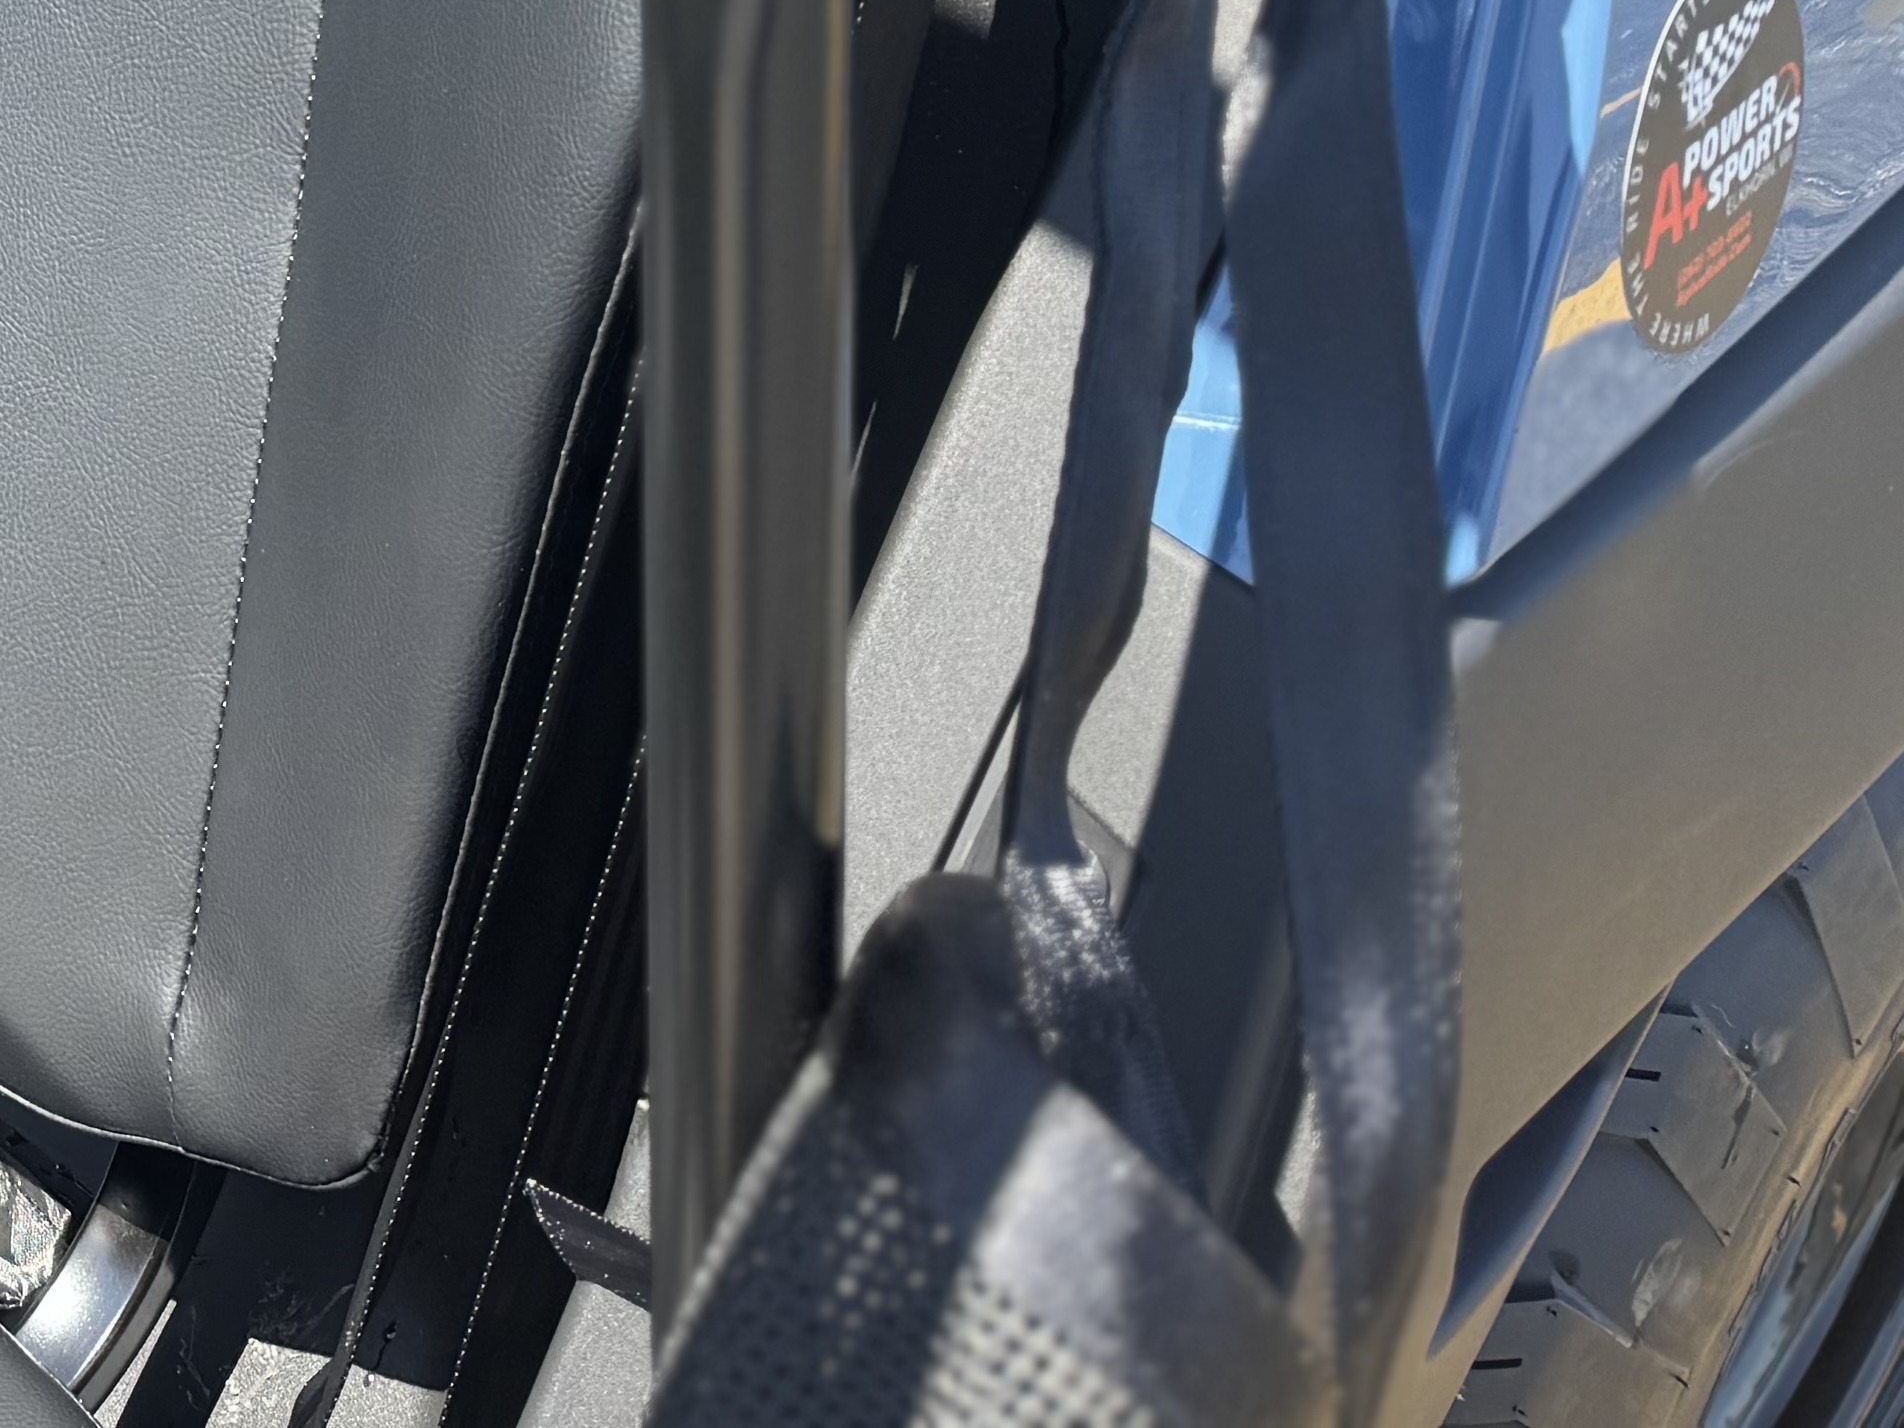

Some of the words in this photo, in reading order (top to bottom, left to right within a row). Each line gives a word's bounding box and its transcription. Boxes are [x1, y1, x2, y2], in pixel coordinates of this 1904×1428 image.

[1682, 74, 1778, 190] POWER
[1706, 95, 1802, 212] SPORTS
[1626, 137, 1649, 233] RIDE
[1643, 161, 1710, 270] A+
[1628, 252, 1649, 317] THE
[1649, 312, 1710, 346] WHERE
